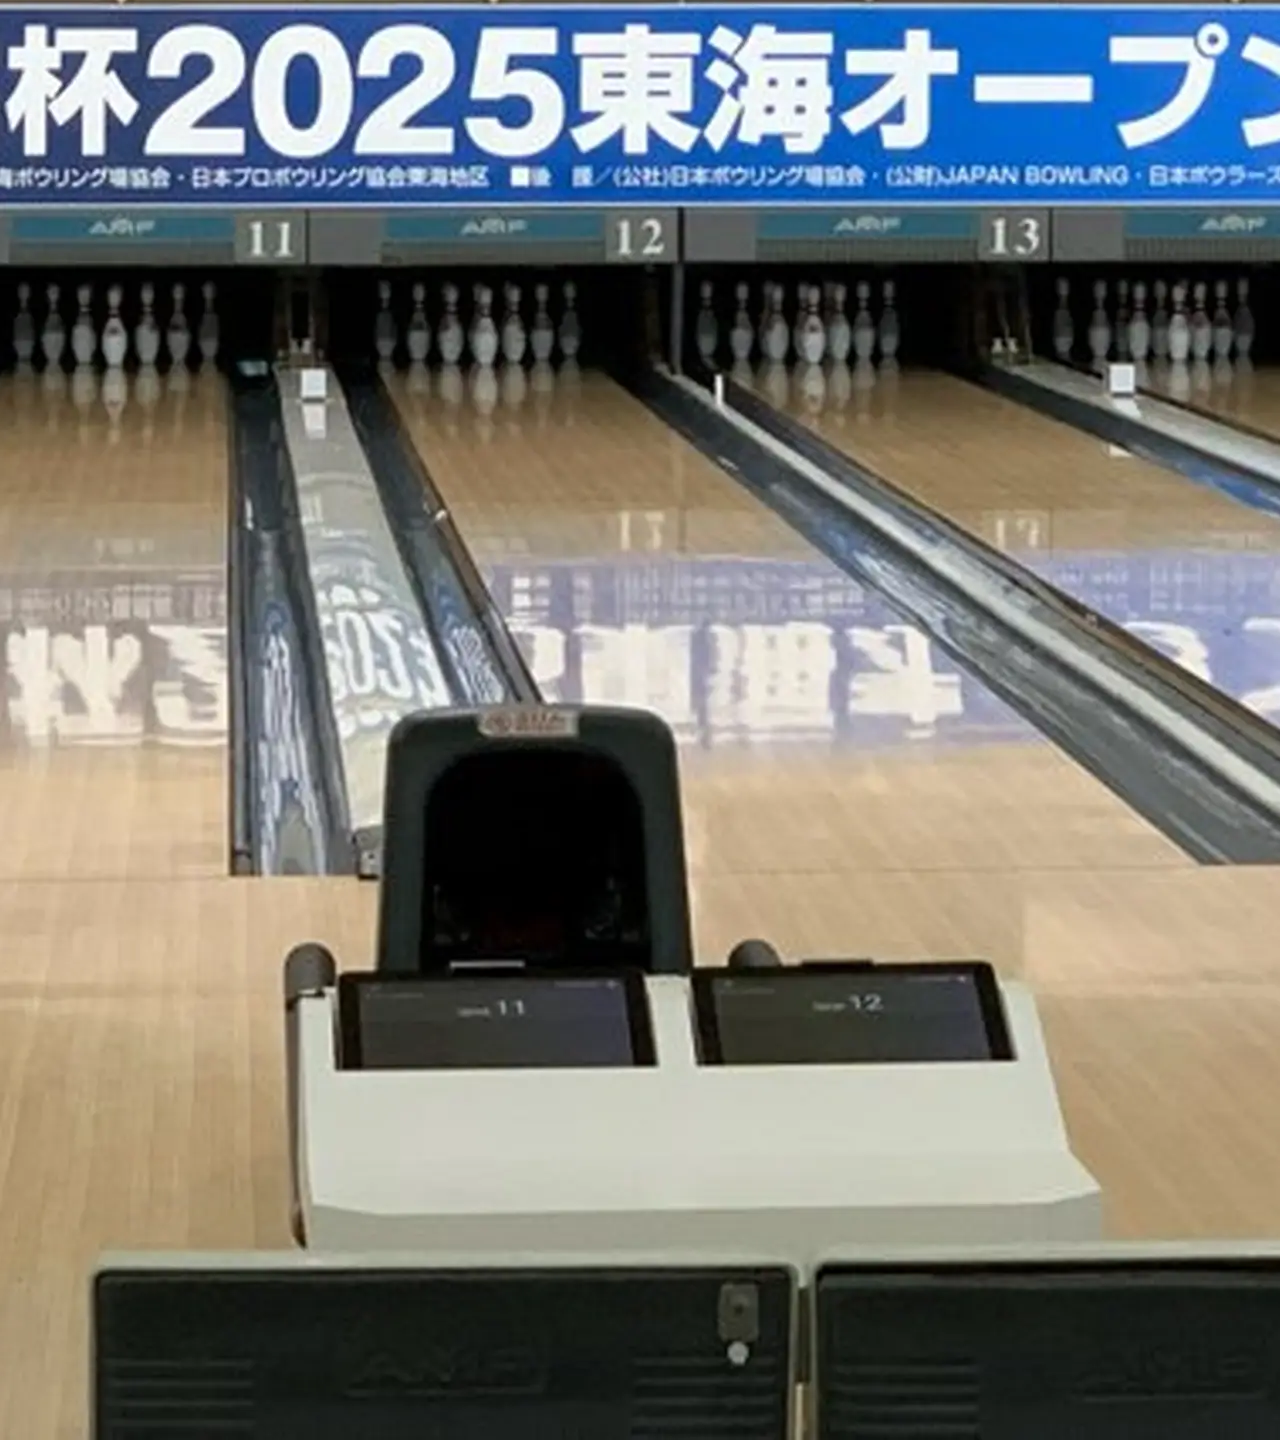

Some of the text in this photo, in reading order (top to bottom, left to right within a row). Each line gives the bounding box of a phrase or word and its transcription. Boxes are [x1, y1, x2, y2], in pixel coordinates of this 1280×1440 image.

[249, 221, 293, 257] 11
[616, 218, 665, 256] 12
[991, 217, 1040, 255] 13
